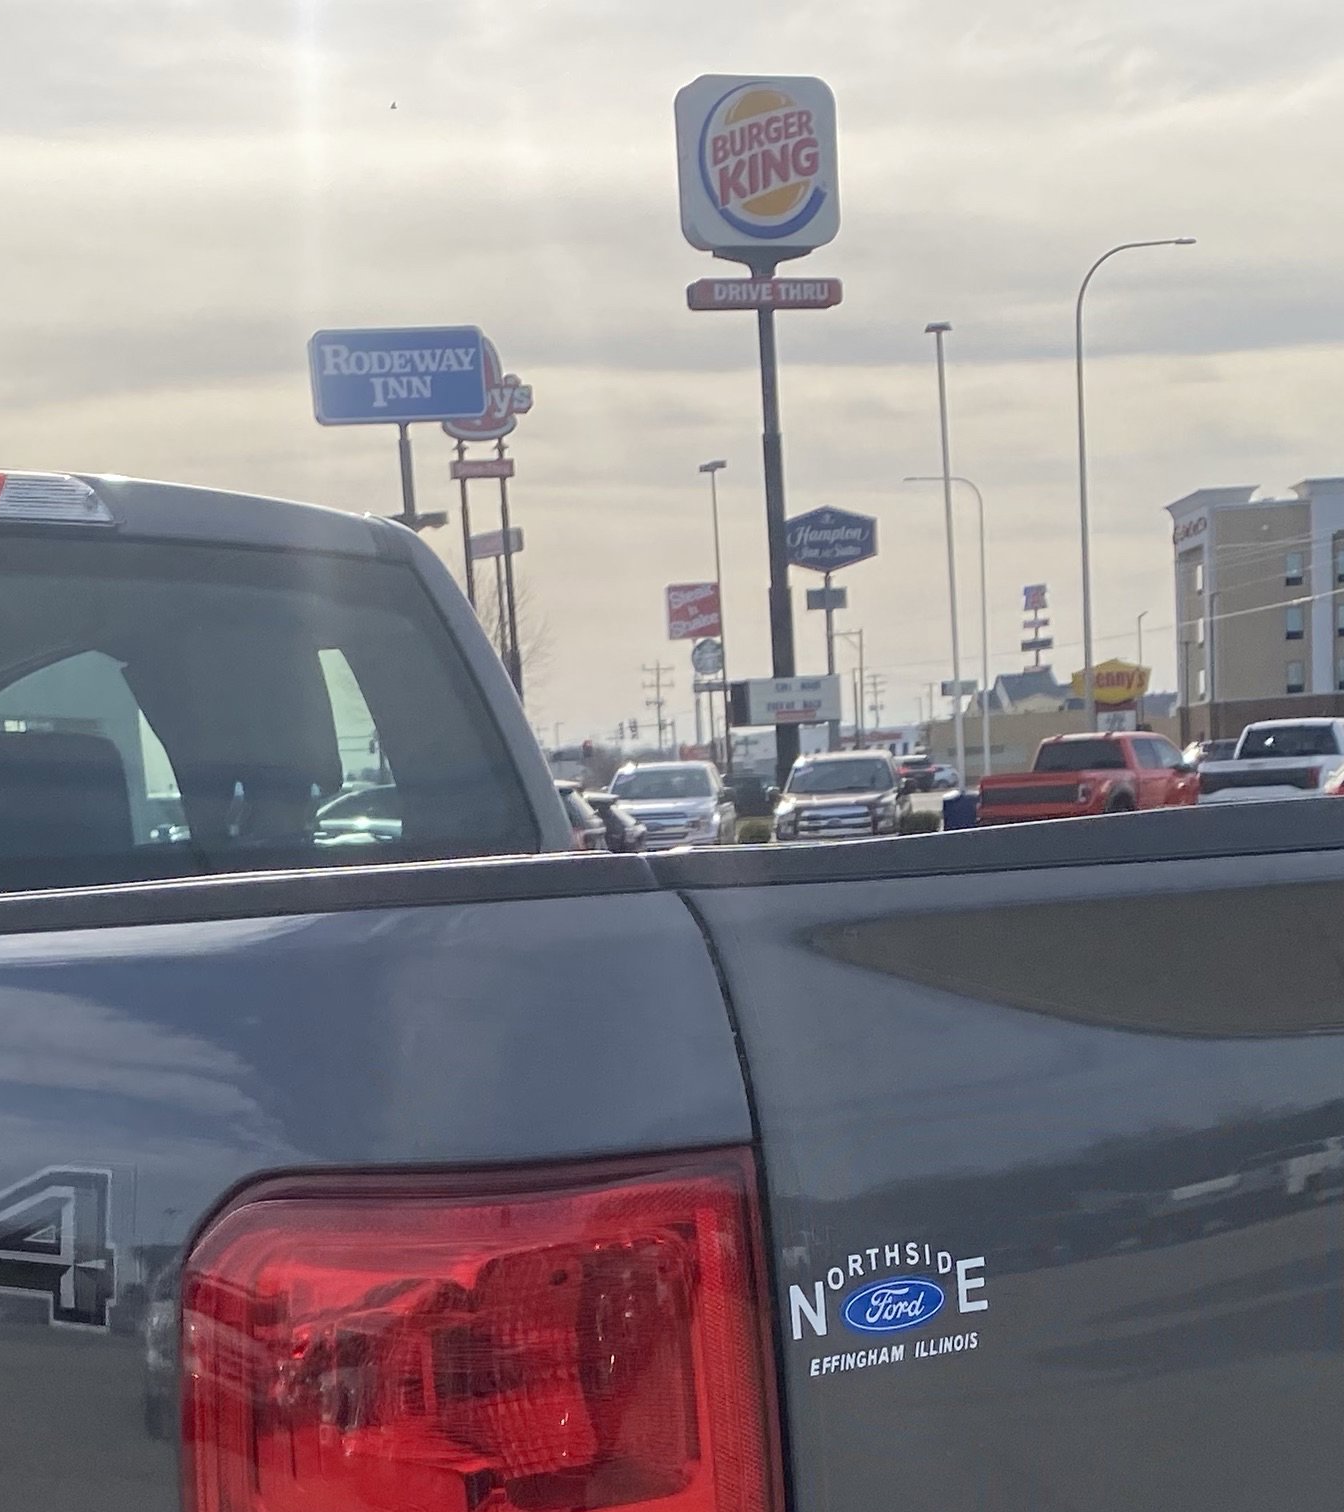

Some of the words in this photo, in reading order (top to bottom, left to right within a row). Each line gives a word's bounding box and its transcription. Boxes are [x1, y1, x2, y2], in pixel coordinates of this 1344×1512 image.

[711, 109, 815, 167] BURGER
[717, 136, 820, 207] KING
[713, 282, 774, 302] DRIVE
[778, 281, 830, 301] THRU
[320, 344, 476, 376] RODEWAY
[369, 375, 432, 408] INN
[786, 525, 870, 547] Hampton
[1085, 670, 1147, 691] enny's
[788, 1241, 989, 1341] NORTHSIDE
[864, 1286, 926, 1324] Ford
[809, 1344, 905, 1377] EFFINGHAM
[914, 1331, 979, 1359] ILLINOIS
